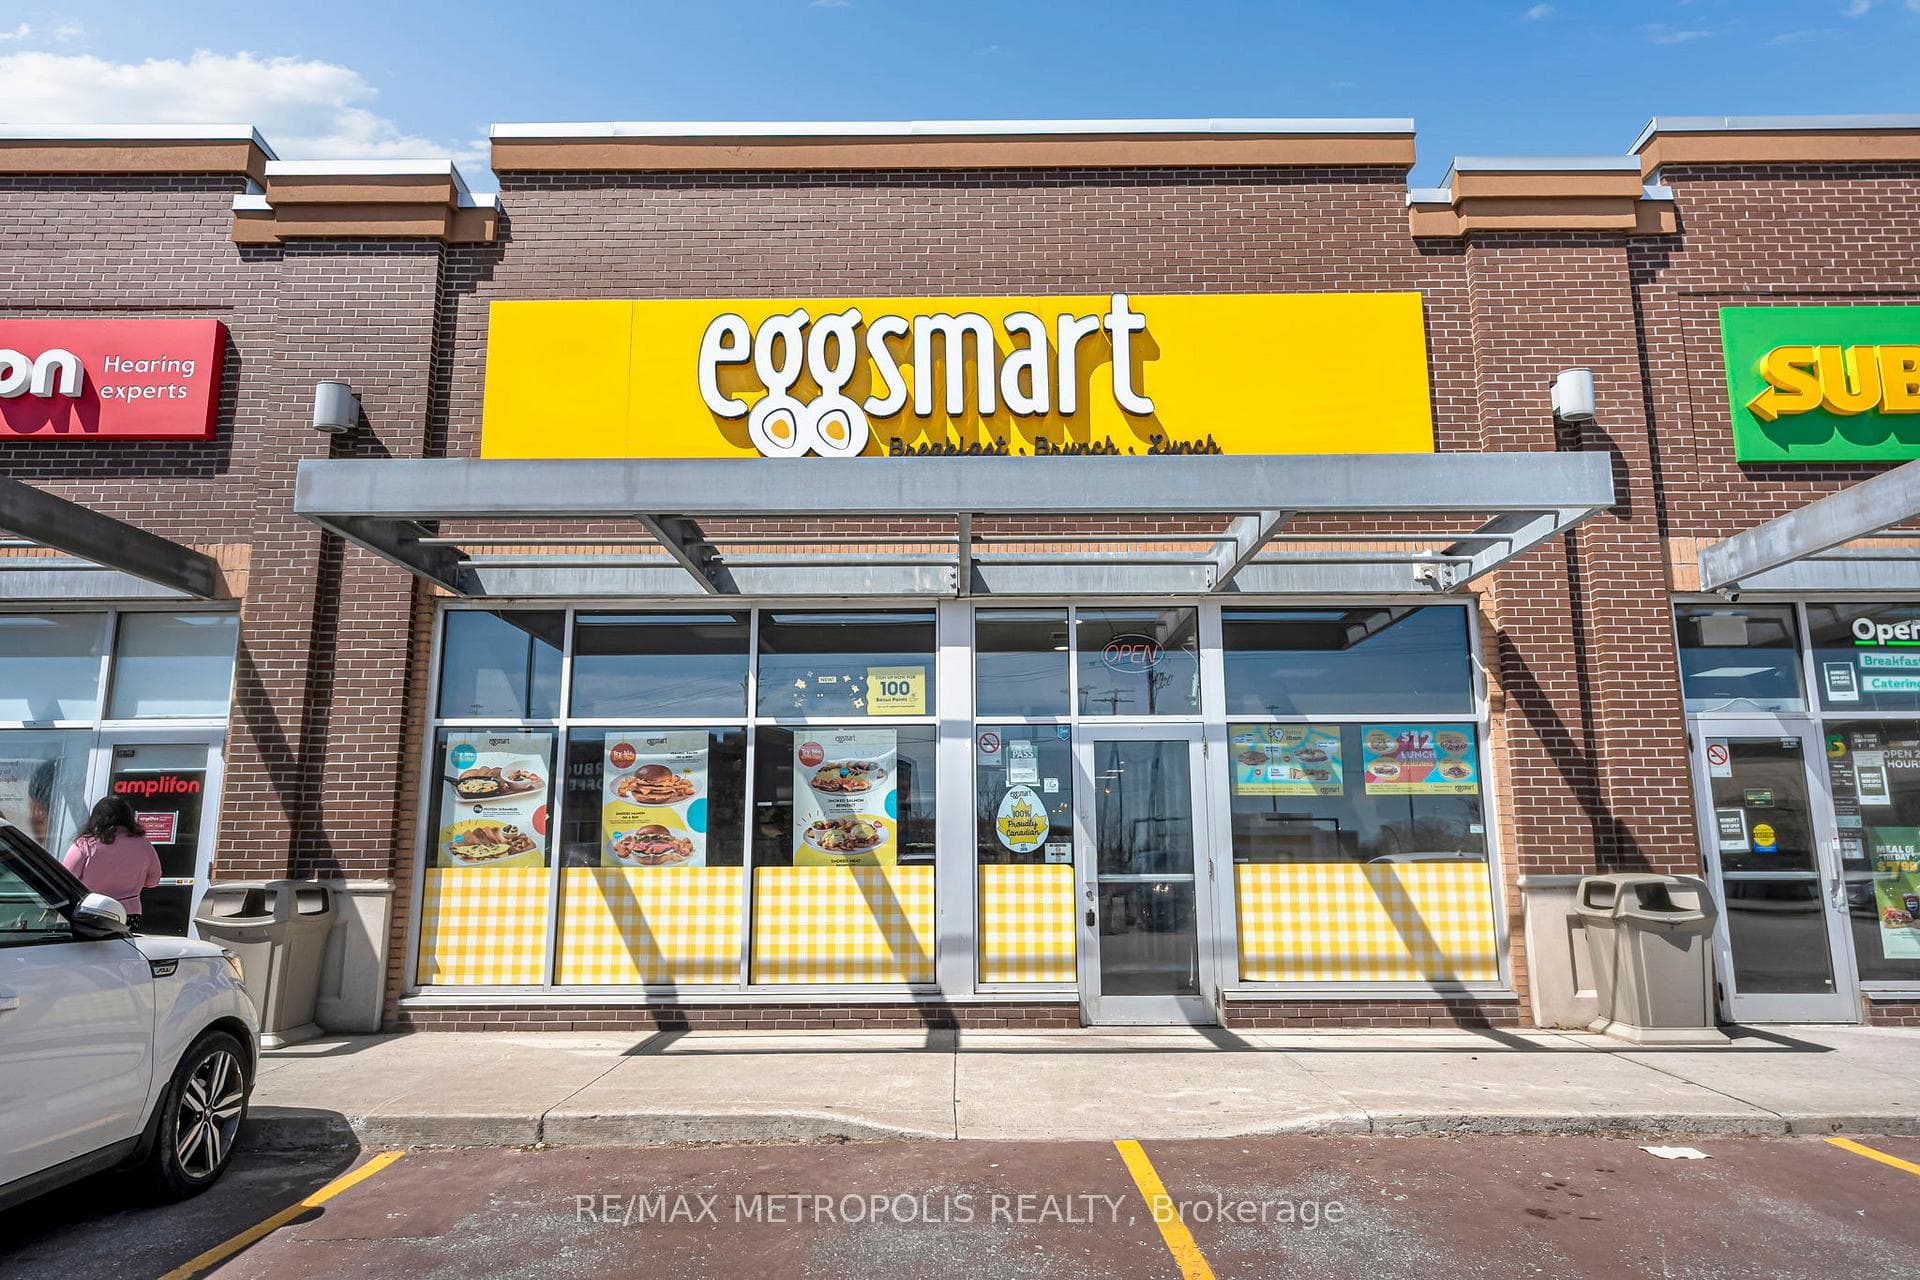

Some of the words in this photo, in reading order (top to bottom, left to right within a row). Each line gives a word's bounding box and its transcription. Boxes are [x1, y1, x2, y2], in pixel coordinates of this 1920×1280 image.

[104, 355, 196, 378] Hearing
[698, 293, 1155, 457] eggsmart
[1745, 344, 1920, 422] SUB
[100, 383, 188, 404] experts
[1104, 644, 1159, 663] OPEN
[880, 681, 910, 696] 100
[1401, 730, 1434, 749] $12
[1012, 750, 1034, 758] PASS
[1401, 750, 1437, 759] LUNCH
[1884, 749, 1913, 758] OPEN
[113, 775, 201, 798] amplifon
[1006, 828, 1040, 837] Canadian
[1008, 820, 1039, 830] Proudly
[1876, 845, 1904, 853] MEAL
